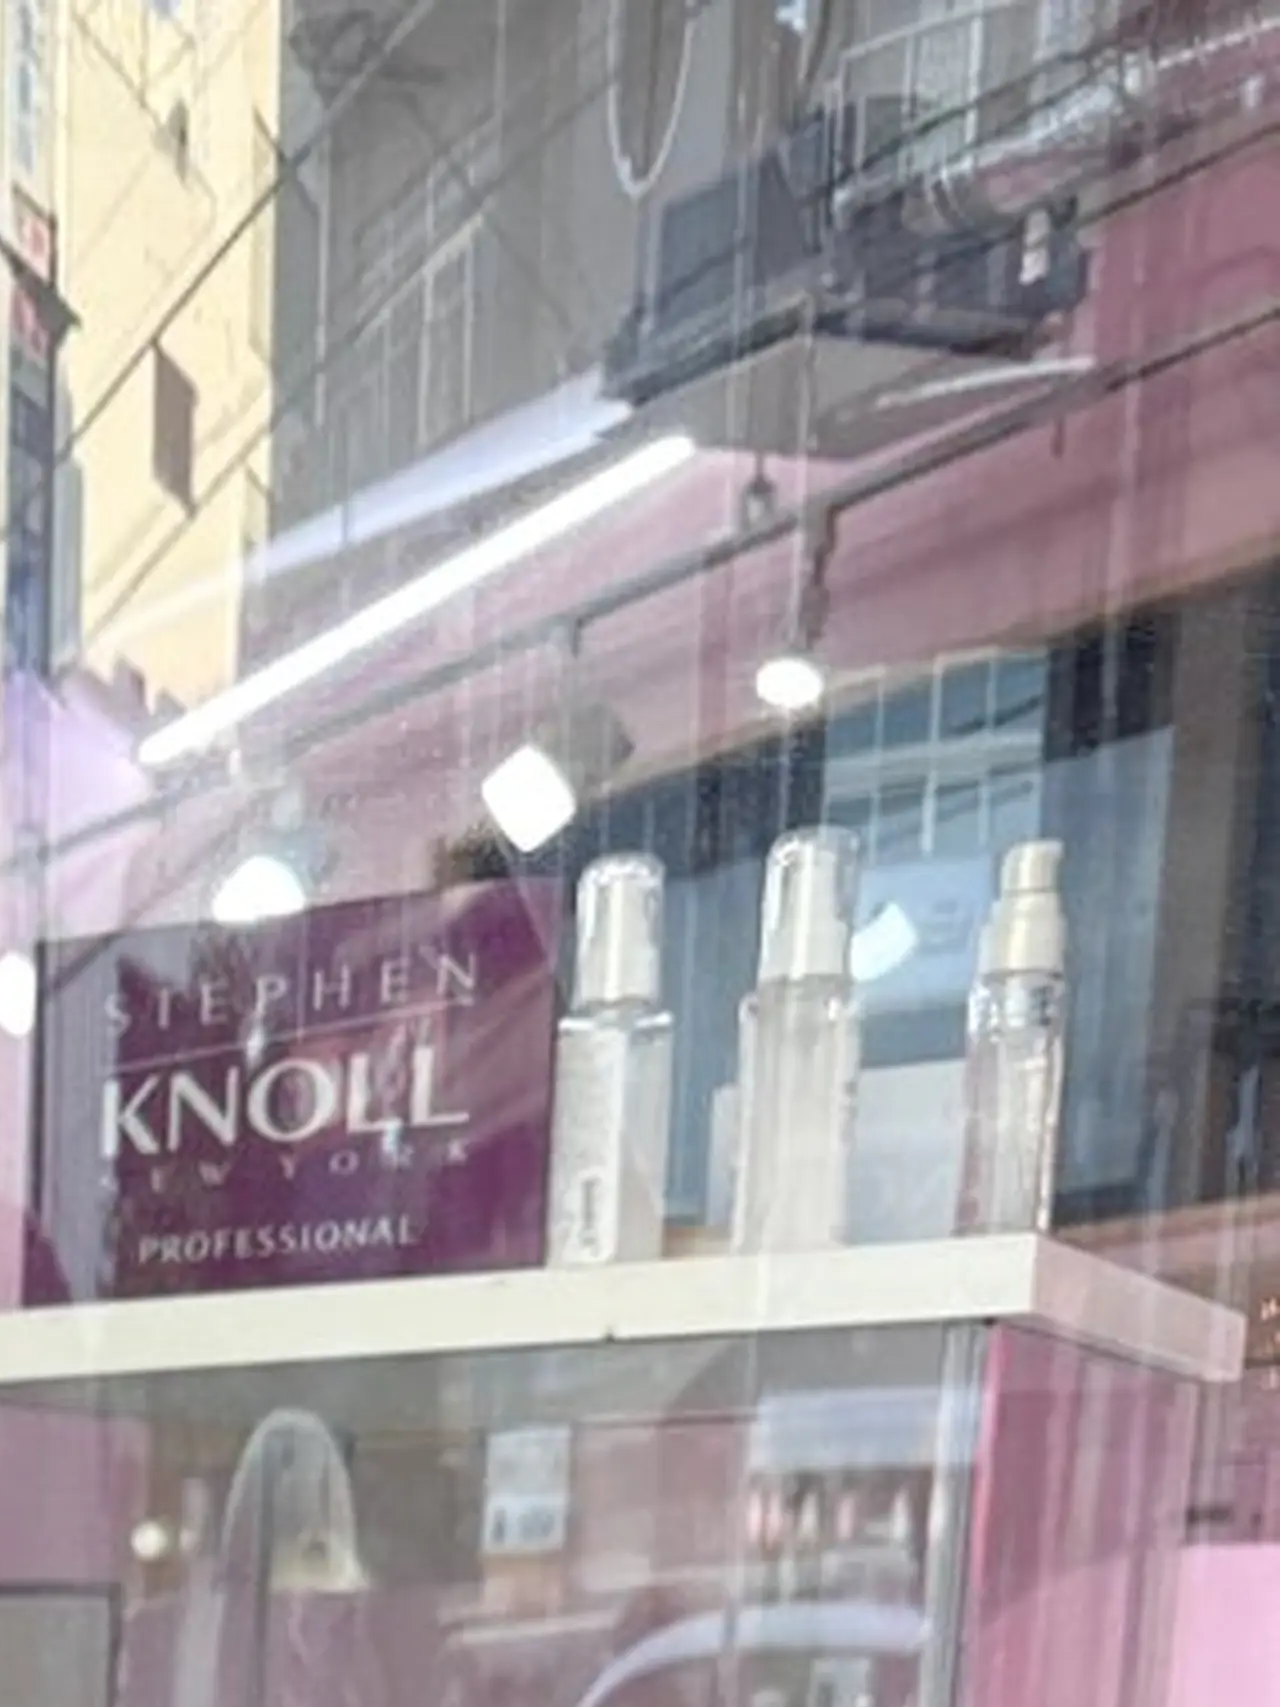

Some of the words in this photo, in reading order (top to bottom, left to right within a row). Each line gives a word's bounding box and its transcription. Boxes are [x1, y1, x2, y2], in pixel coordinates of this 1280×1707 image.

[104, 951, 476, 1038] STEPHEN
[100, 1045, 469, 1158] KNOLL
[140, 1215, 418, 1263] PROFESSIONAL
